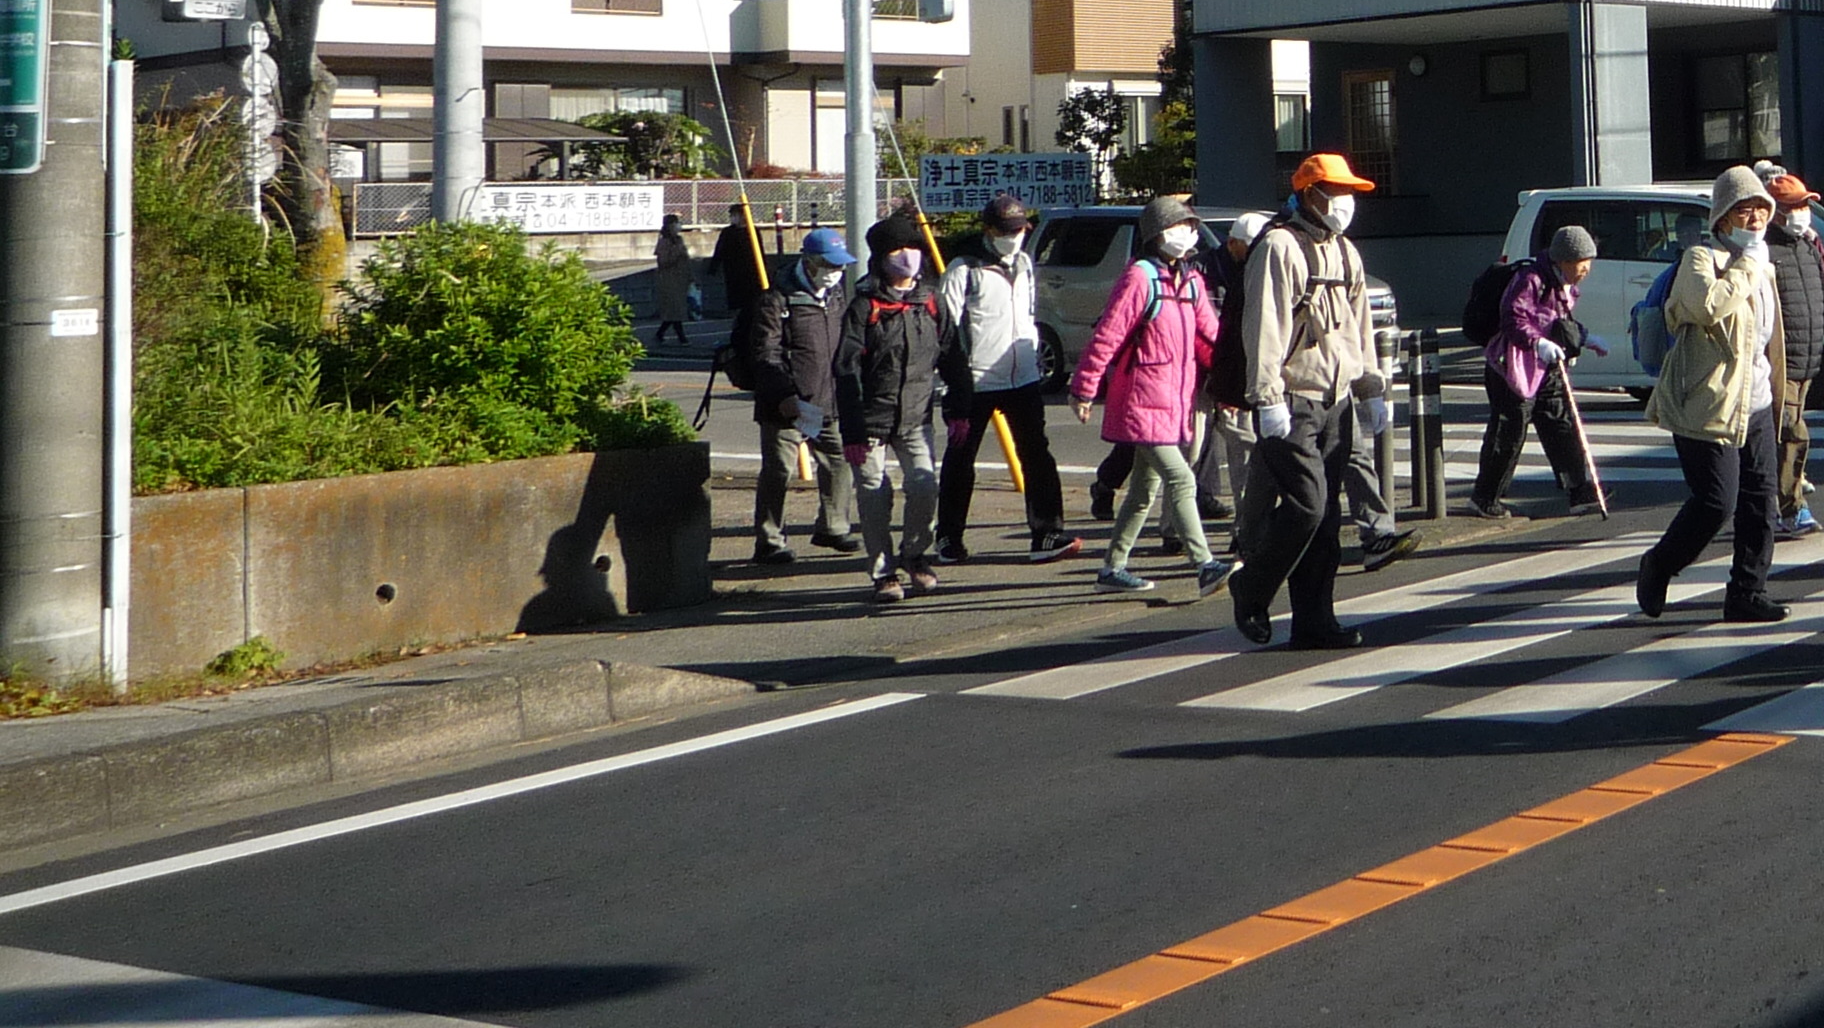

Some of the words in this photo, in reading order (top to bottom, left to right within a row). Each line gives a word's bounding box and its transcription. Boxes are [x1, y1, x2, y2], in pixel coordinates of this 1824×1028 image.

[194, 1, 237, 17] ここから
[481, 191, 577, 213] 真宗本派
